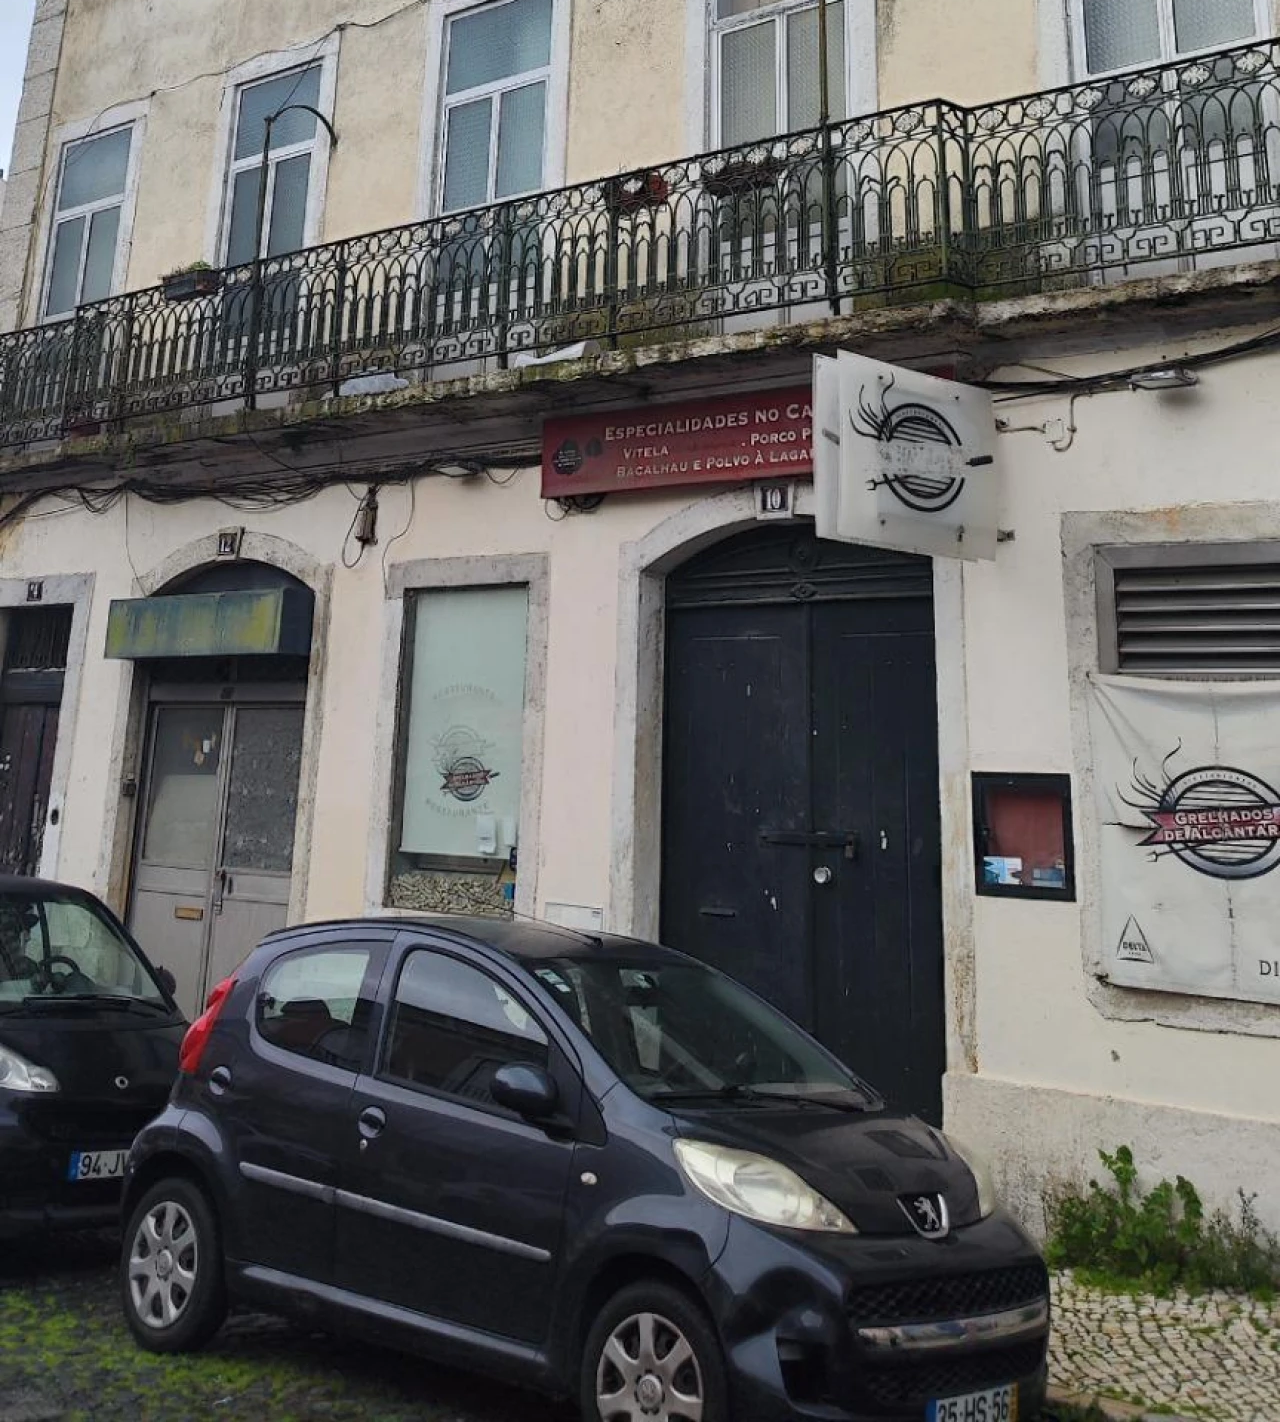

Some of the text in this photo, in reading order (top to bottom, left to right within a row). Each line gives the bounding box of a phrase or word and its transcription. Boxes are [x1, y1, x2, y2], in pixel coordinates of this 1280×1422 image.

[605, 411, 748, 441] ESPECIALIDADES
[755, 408, 779, 424] NO
[623, 445, 669, 459] VITELA
[750, 430, 797, 446] PORCO
[616, 461, 688, 477] BACALHAU
[692, 460, 702, 471] E
[706, 455, 750, 469] POLVO
[765, 488, 782, 509] 10
[220, 536, 232, 552] 12
[1174, 808, 1274, 825] GRELHADOS
[1163, 828, 1185, 841] DE
[1258, 959, 1280, 977] DI
